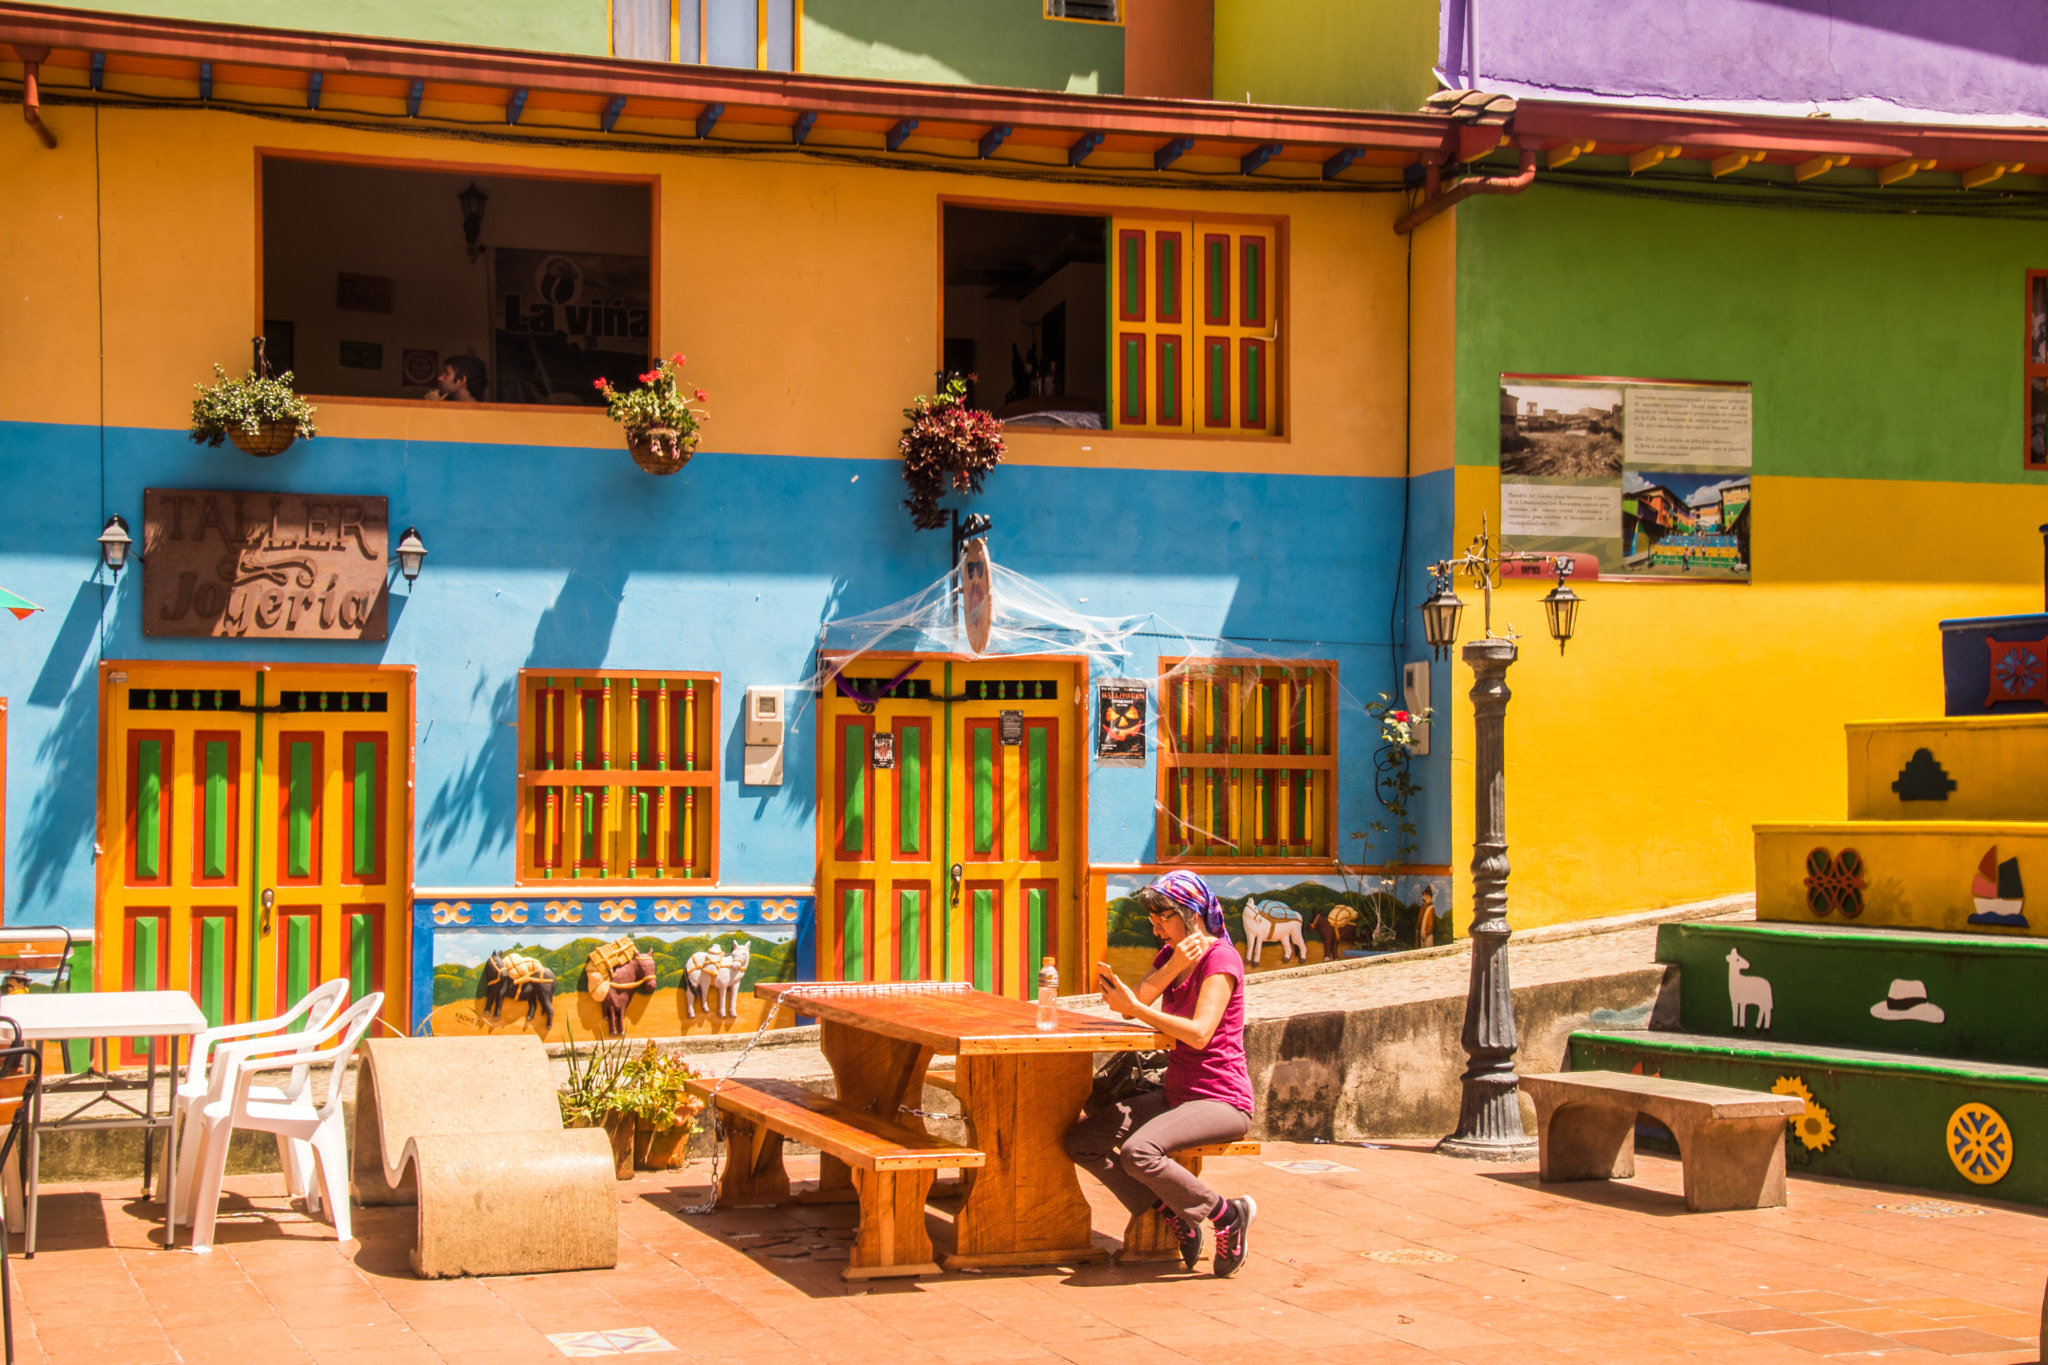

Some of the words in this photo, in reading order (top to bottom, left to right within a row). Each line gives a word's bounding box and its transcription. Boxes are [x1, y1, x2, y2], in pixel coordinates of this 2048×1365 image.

[505, 294, 554, 334] La
[160, 495, 379, 560] TALLER
[160, 571, 377, 637] Joyería
[1101, 691, 1145, 700] HALLOWEEN
[874, 749, 893, 759] HOUR
